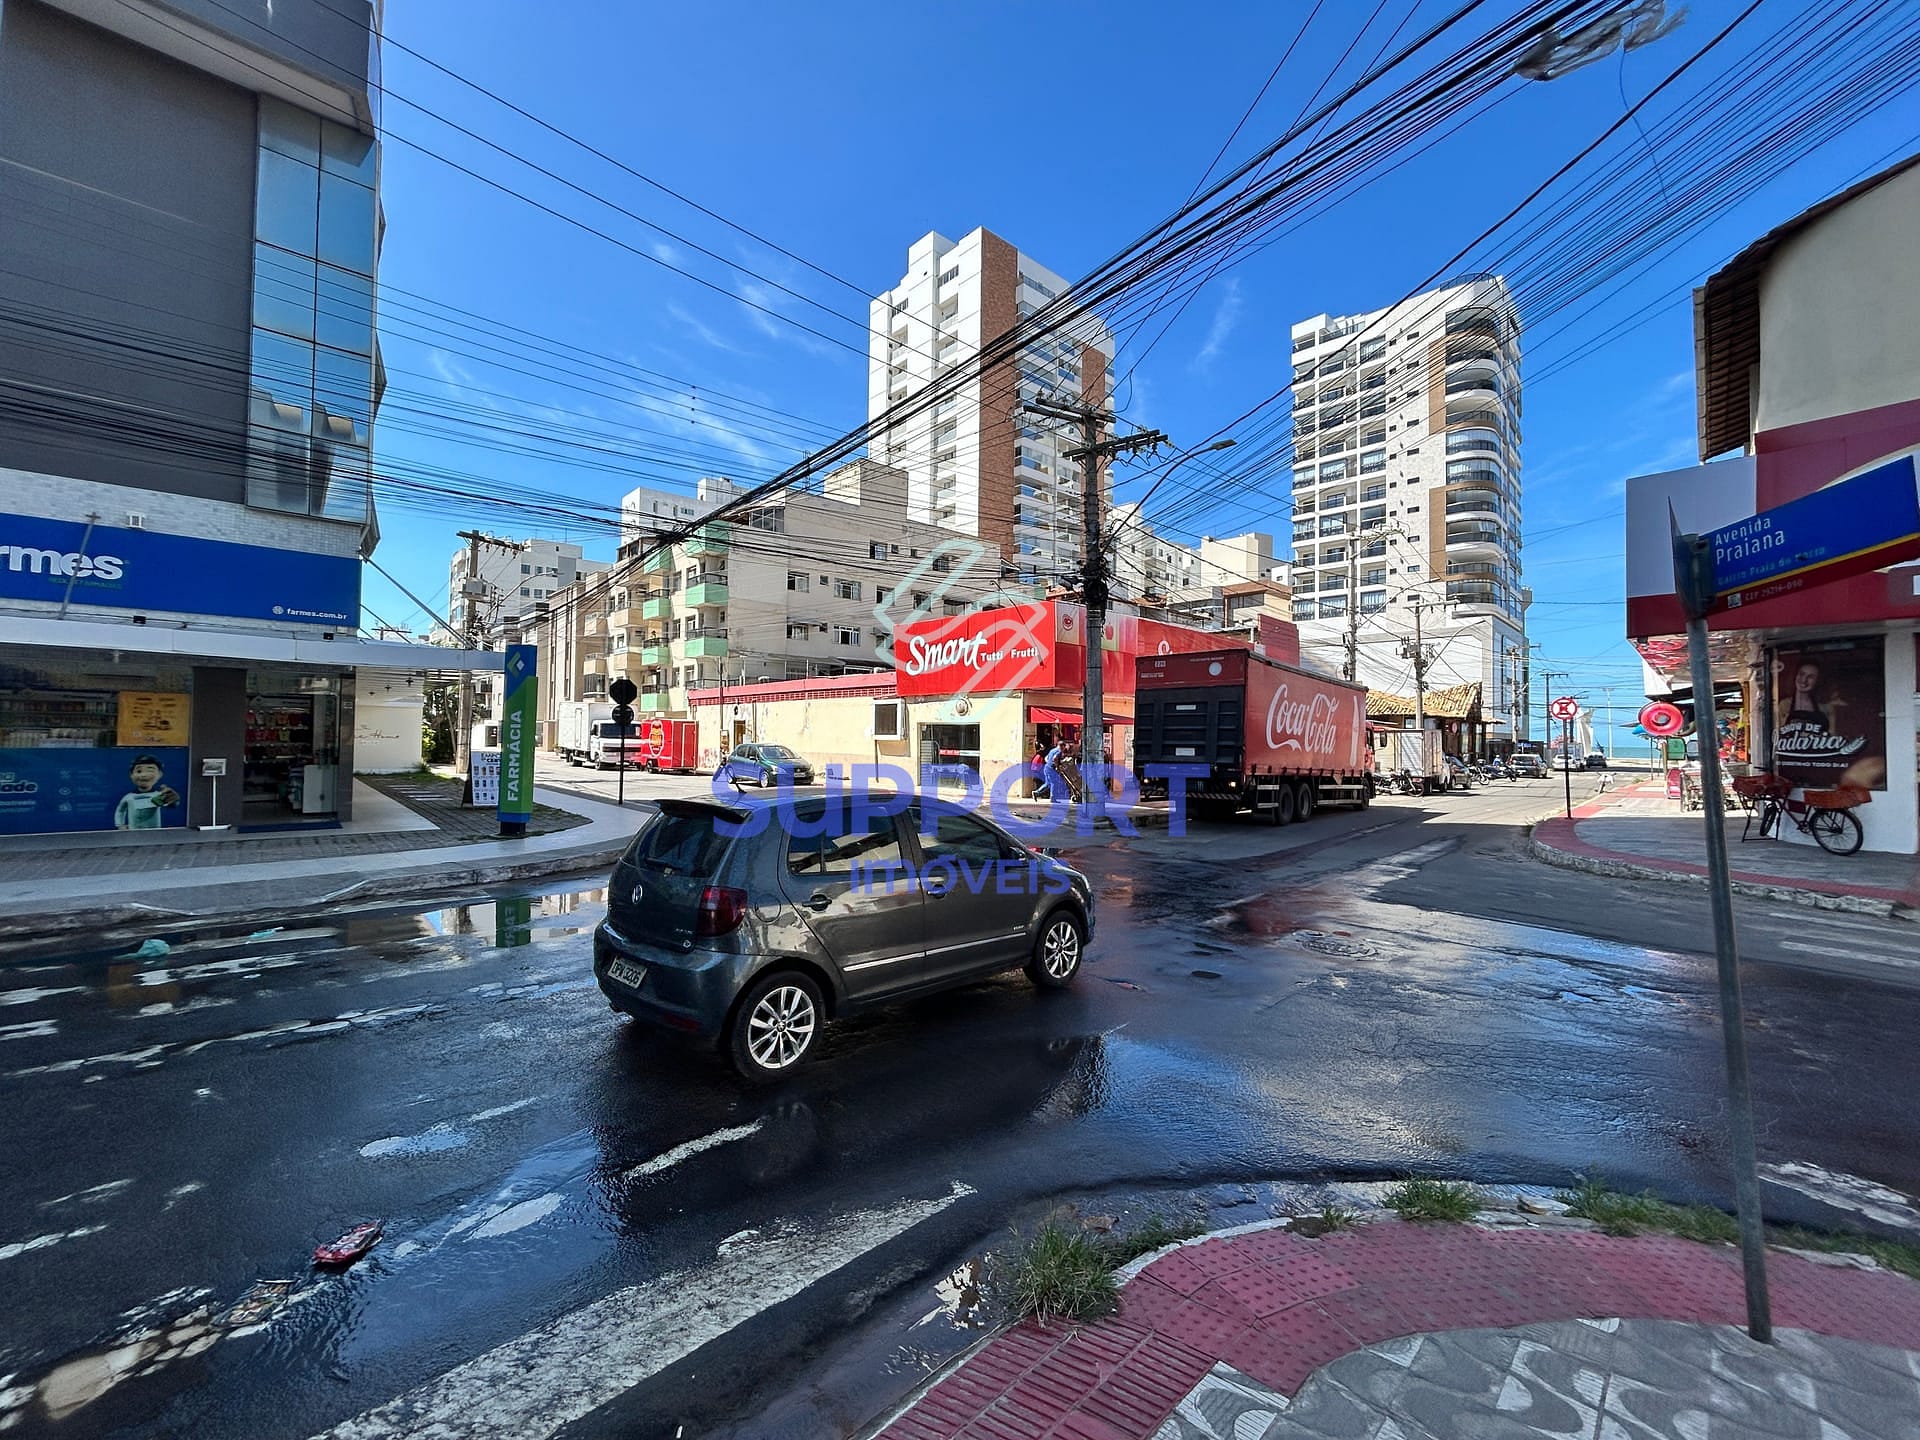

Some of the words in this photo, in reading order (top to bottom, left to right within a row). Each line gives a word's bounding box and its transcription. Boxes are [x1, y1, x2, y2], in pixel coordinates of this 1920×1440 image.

[1715, 518, 1771, 546] Avenida
[1716, 530, 1785, 565] Praiana
[287, 608, 347, 620] farmes.com.br
[906, 631, 988, 676] Smart
[981, 650, 1003, 662] Tutti
[1011, 647, 1038, 659] Frutti
[1780, 722, 1802, 734] SHOW
[1805, 723, 1822, 733] DE
[507, 710, 522, 801] FARMÁCIA
